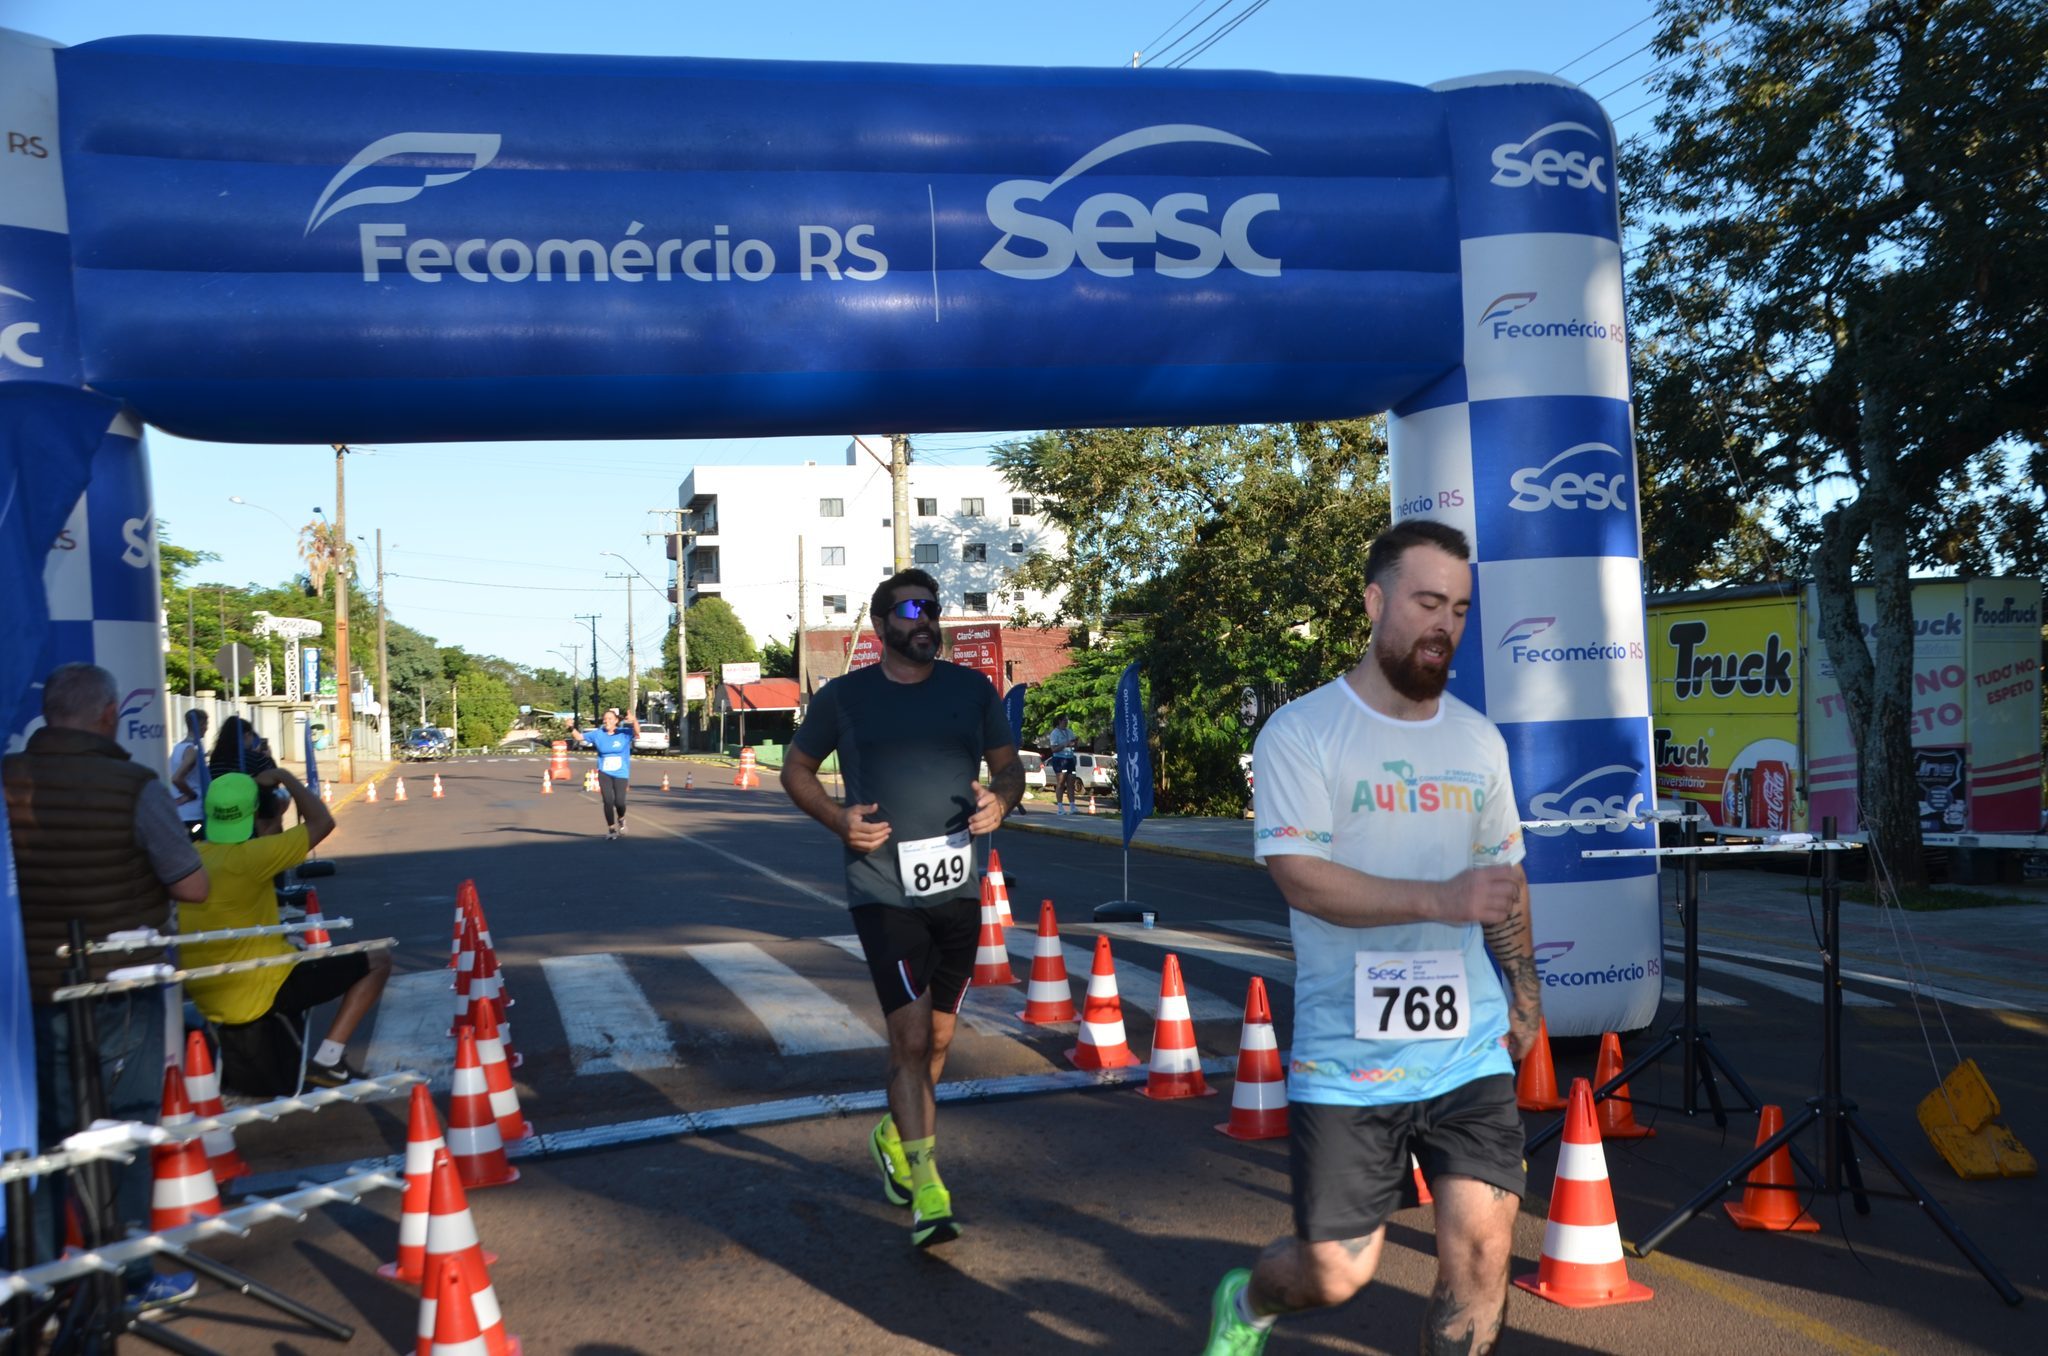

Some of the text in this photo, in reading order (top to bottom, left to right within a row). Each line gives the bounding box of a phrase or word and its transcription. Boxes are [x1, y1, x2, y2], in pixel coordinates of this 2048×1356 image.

[7, 131, 49, 159] RS
[1490, 142, 1607, 193] Sesc
[980, 178, 1282, 280] Sesc
[358, 220, 889, 283] Fecomércio RS
[1493, 318, 1624, 344] Fecomércio RS
[1438, 489, 1465, 509] RS
[1507, 467, 1628, 512] Sesc
[1512, 642, 1644, 664] Fecomércio RS
[1668, 620, 1793, 700] Truck
[1914, 664, 1967, 696] NO
[1986, 680, 2034, 705] ESPETO
[1351, 779, 1485, 813] Autismo
[1657, 775, 1706, 789] niversitário
[1523, 792, 1647, 838] Sesc
[913, 855, 964, 892] 849
[1367, 966, 1407, 980] Sesc
[1648, 958, 1660, 977] RS
[1372, 984, 1459, 1033] 768
